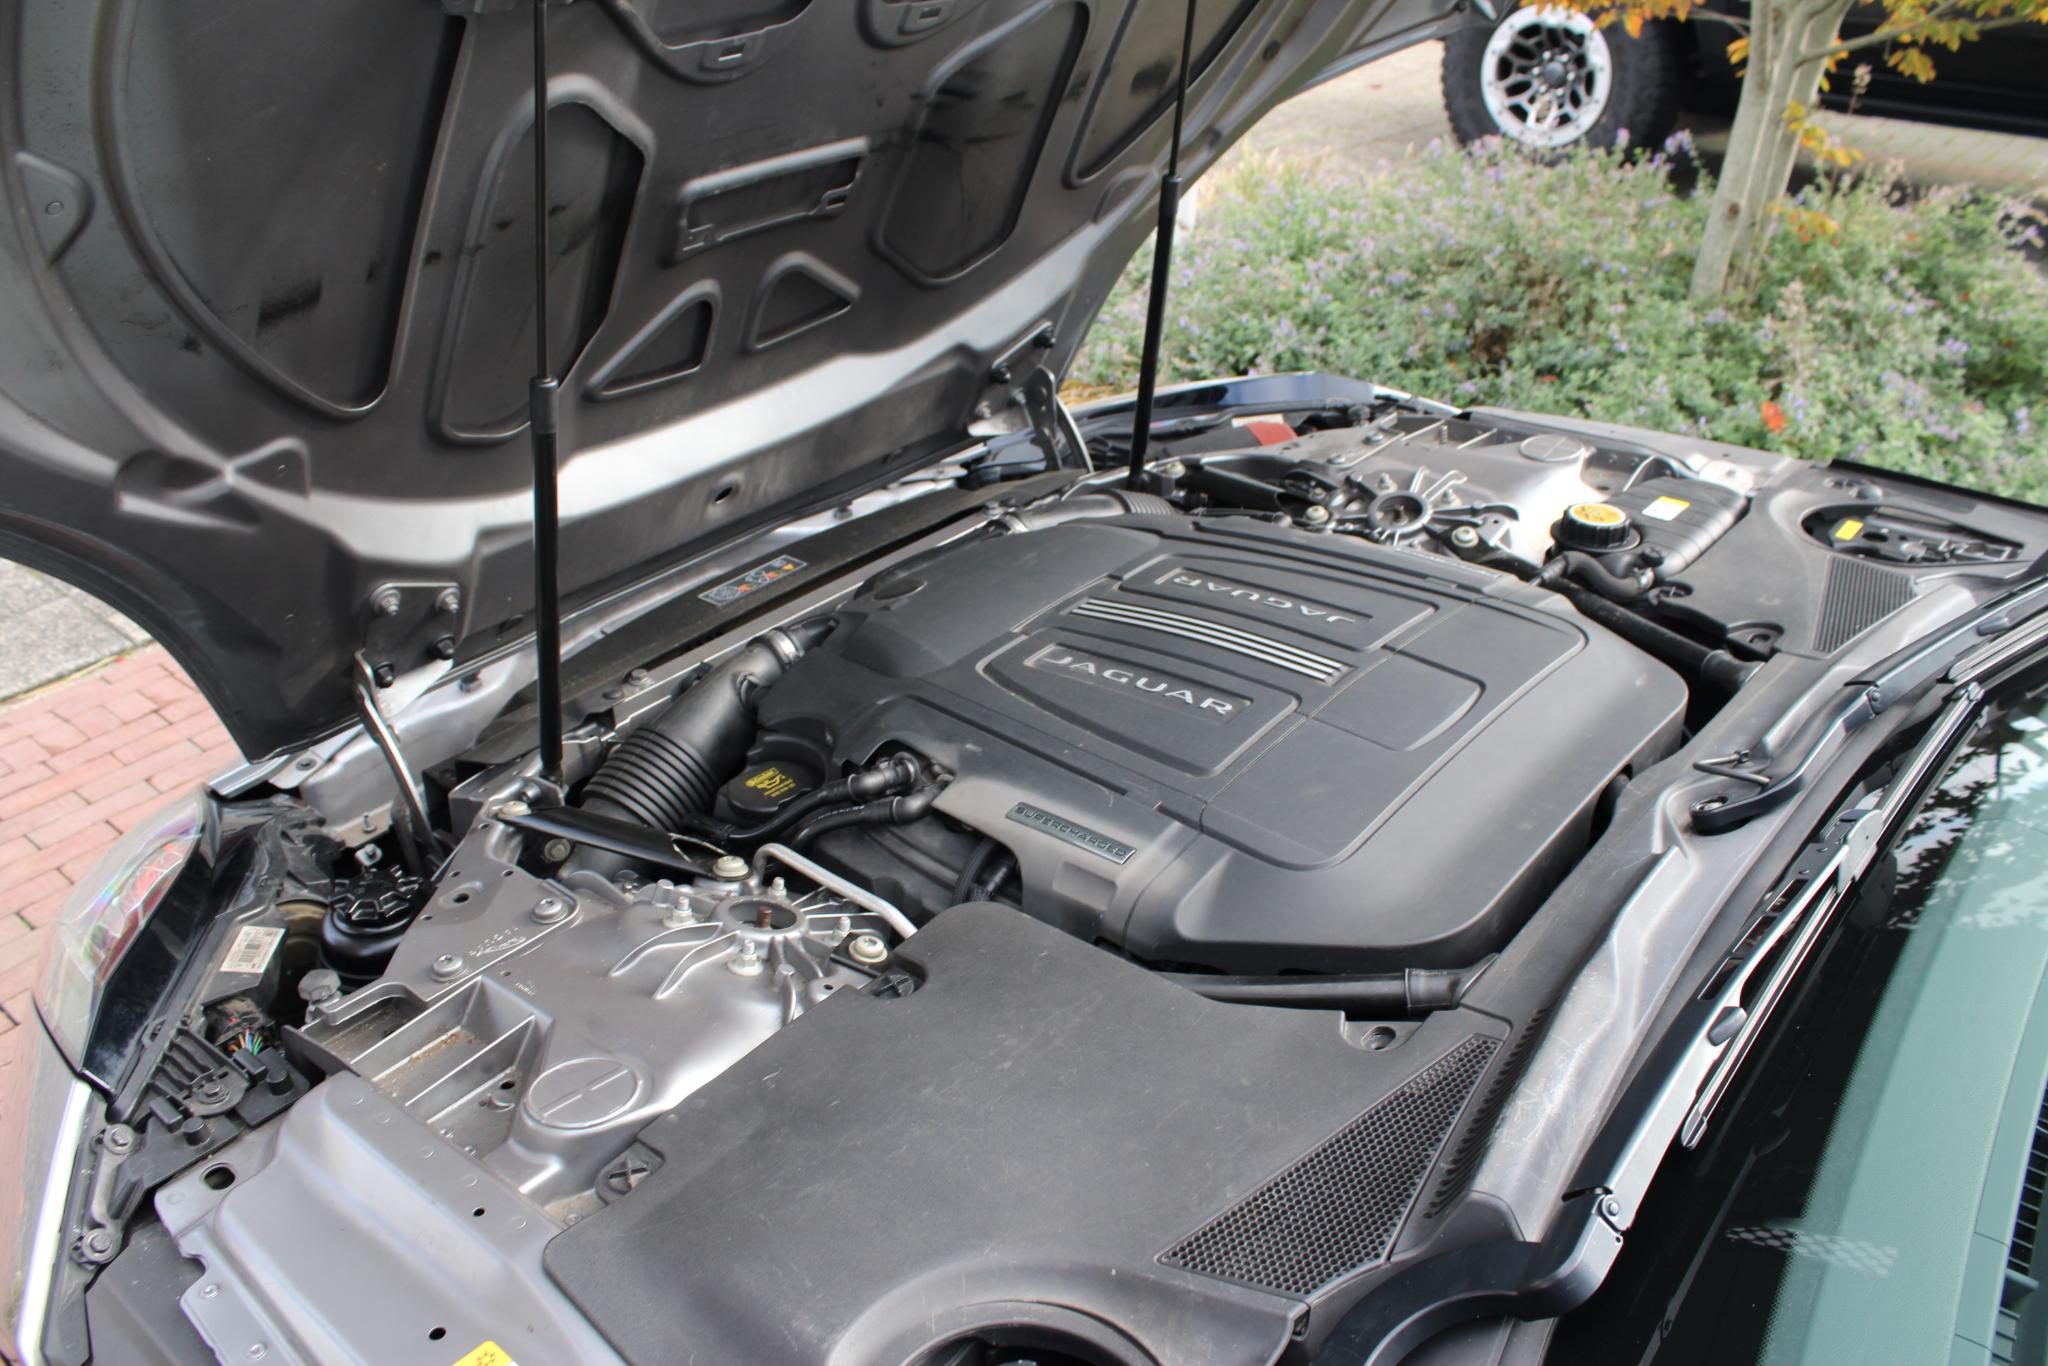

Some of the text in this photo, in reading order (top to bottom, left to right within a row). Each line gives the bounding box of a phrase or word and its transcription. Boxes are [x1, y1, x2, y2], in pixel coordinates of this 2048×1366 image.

[1172, 575, 1356, 624] JAGUAR
[1042, 655, 1234, 715] JAGUAR
[1015, 806, 1127, 857] SUPERCHARGED
